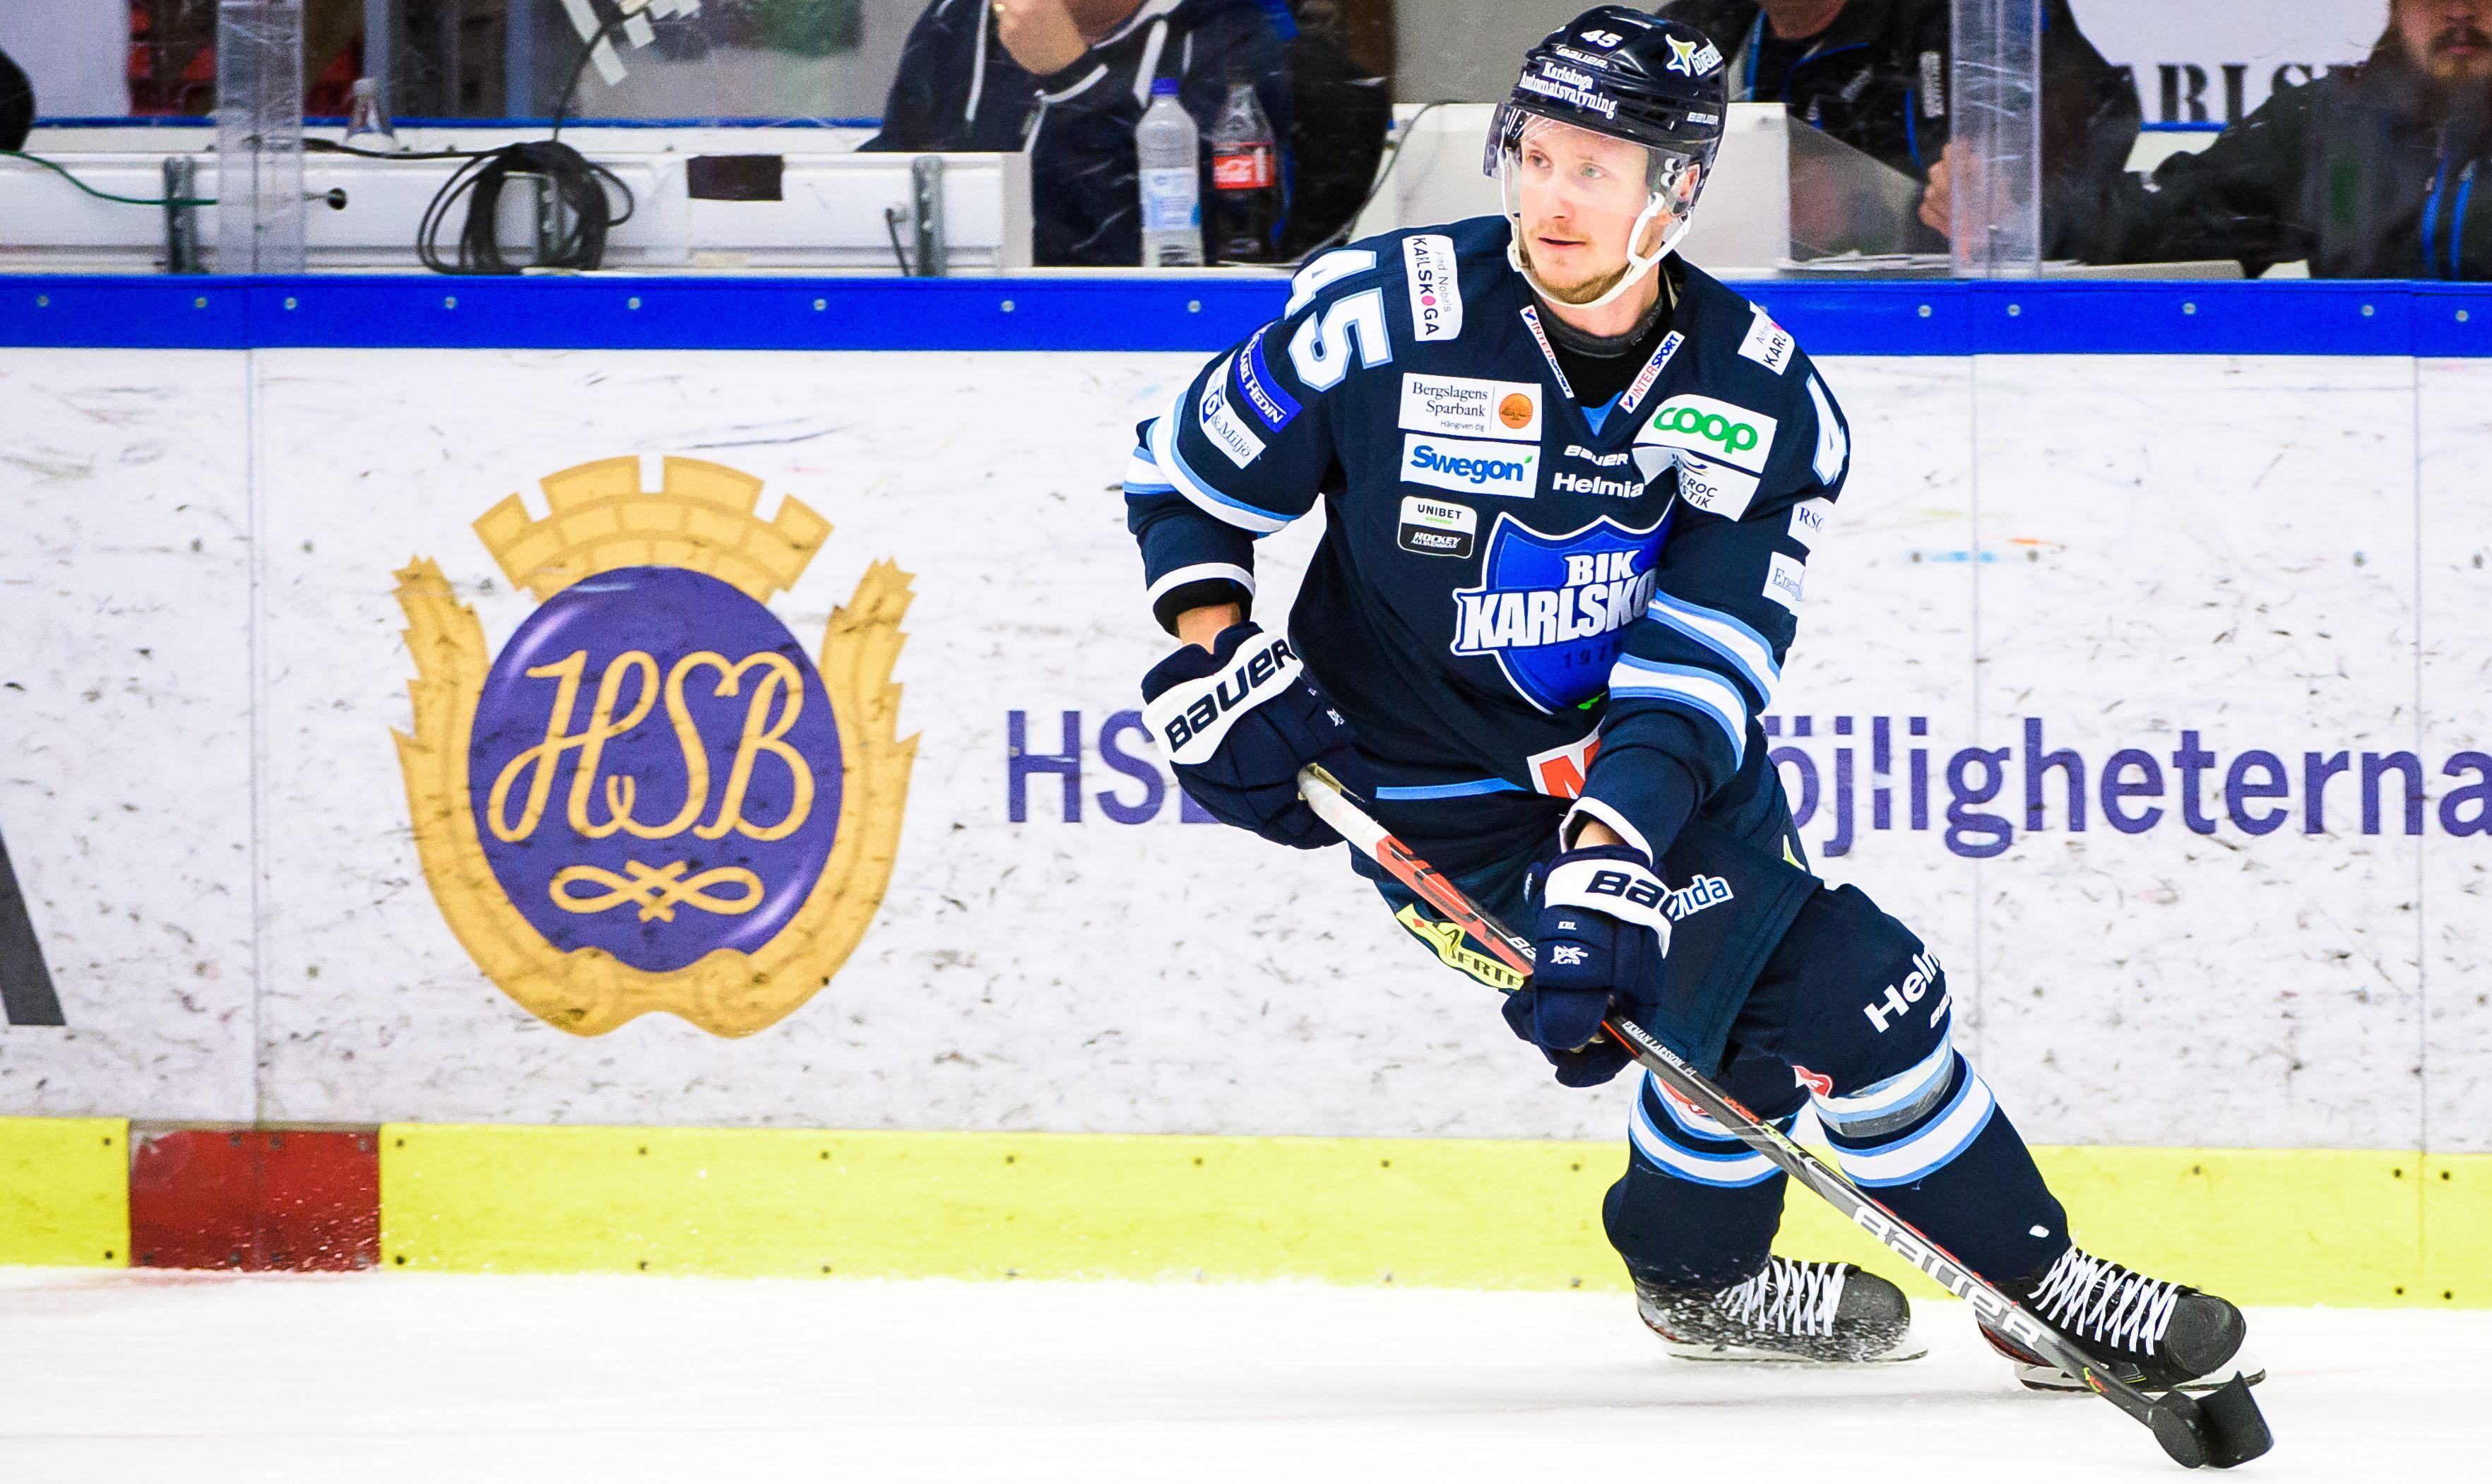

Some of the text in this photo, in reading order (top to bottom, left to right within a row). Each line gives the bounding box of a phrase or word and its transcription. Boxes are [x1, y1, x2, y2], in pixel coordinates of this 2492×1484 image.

[1581, 30, 1623, 48] 45
[1556, 46, 1608, 70] BAUER
[1542, 61, 1594, 91] Karlskoga
[1284, 249, 1393, 393] 45
[1763, 332, 1787, 367] KARL
[1631, 333, 1680, 399] INTERSPORT
[1245, 379, 1284, 424] HEDIN
[1412, 381, 1488, 402] Bergslagens
[1425, 400, 1486, 417] Sparbank
[1475, 422, 1485, 432] dig
[1653, 407, 1758, 454] coop
[1805, 372, 1848, 486] 4
[1411, 445, 1524, 484] Swegon
[1564, 444, 1629, 467] BAUER
[1553, 473, 1645, 499] Helmia
[1681, 485, 1711, 509] STIK
[1682, 471, 1718, 498] EROC
[1417, 504, 1463, 521] UNIBET
[1413, 531, 1462, 546] HOCKEY
[1563, 550, 1640, 588] BIK
[1164, 638, 1298, 753] BAUER
[487, 649, 816, 842] HSB
[1008, 709, 1223, 825] HS
[1764, 714, 2492, 859] öjligheterna
[1649, 1040, 1685, 1067] LARSSON
[1852, 1205, 2041, 1351] BAUER
